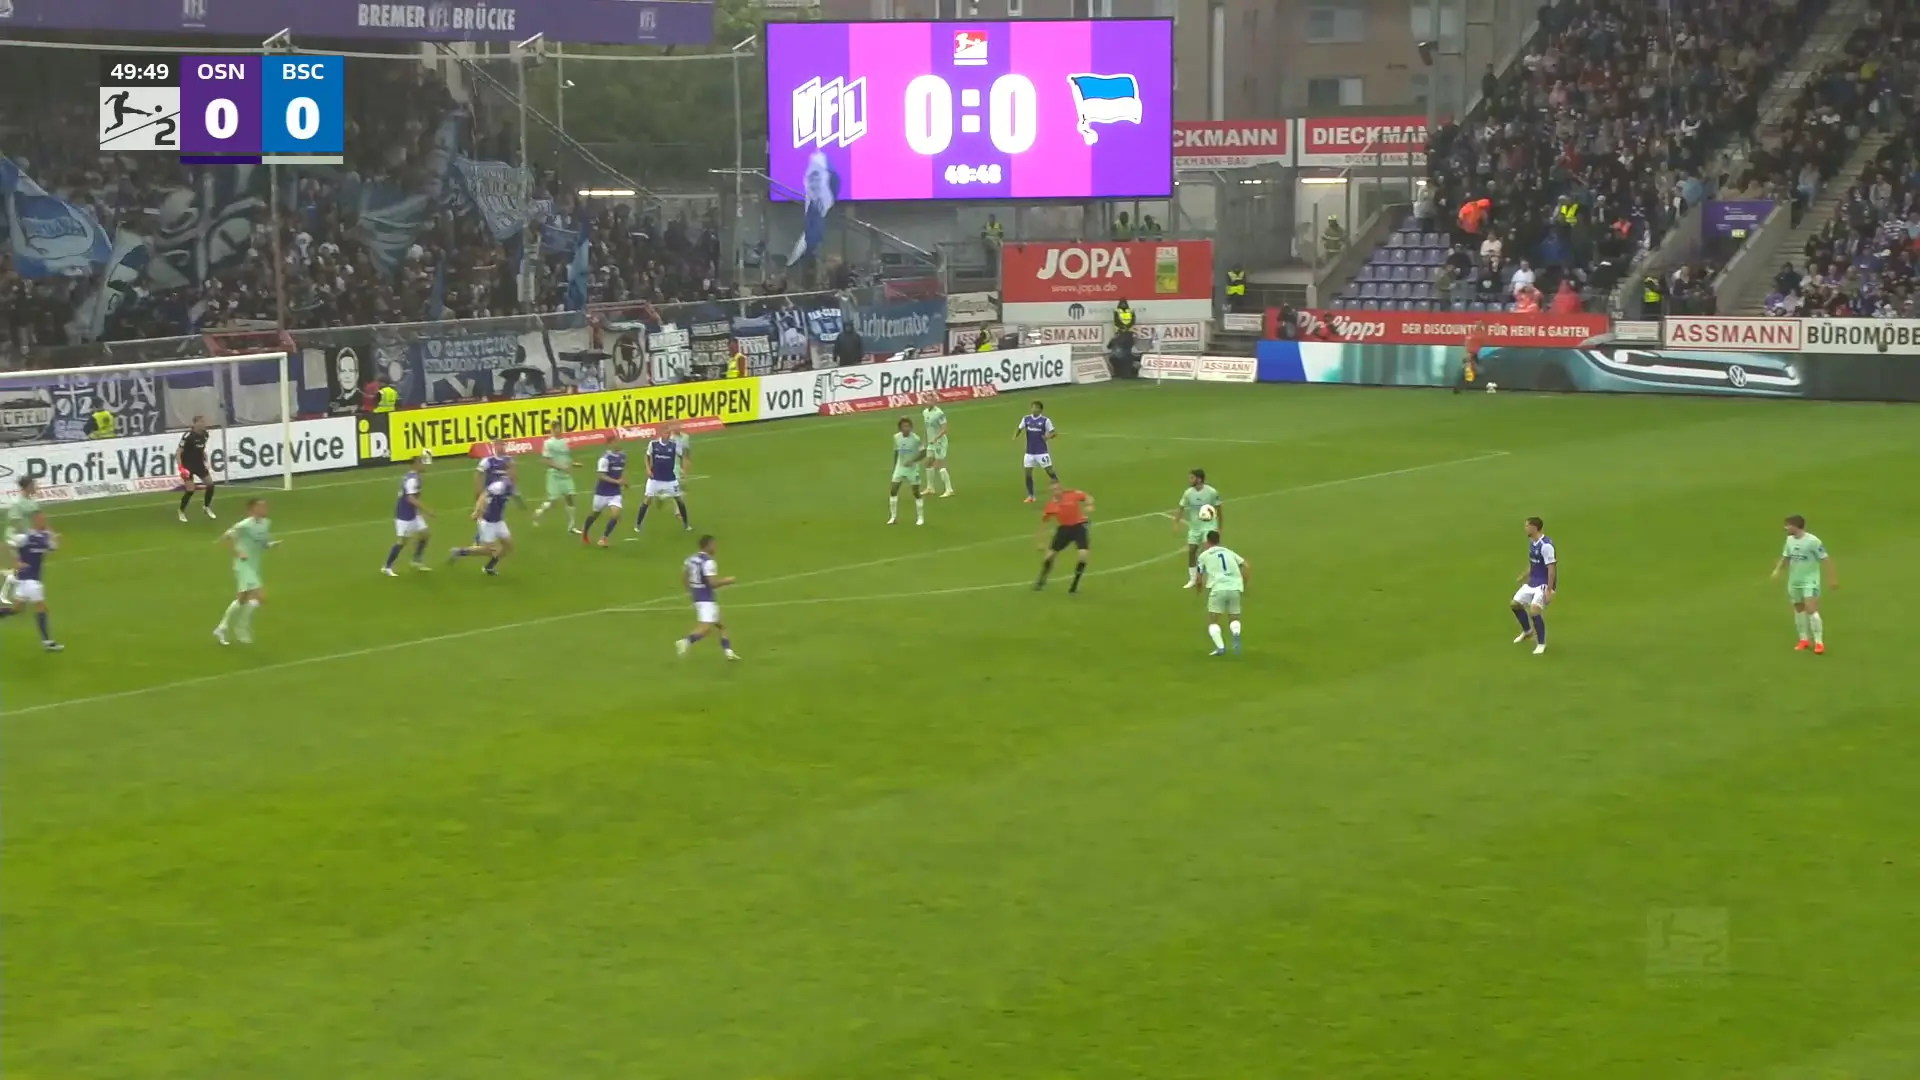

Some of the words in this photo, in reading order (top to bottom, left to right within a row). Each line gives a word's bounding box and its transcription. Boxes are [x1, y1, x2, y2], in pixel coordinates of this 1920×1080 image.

[358, 4, 425, 28] BREMER
[453, 2, 516, 31] BRÜCKE
[1173, 128, 1278, 147] CKMANN
[1312, 126, 1428, 145] DIECKMAN
[1036, 247, 1132, 280] JOPA
[1051, 283, 1118, 294] www.jopa.de
[853, 312, 930, 341] Lichtenrade
[1043, 328, 1099, 343] SMANN
[1296, 311, 1386, 341] Phlipps
[1402, 323, 1421, 335] DER
[1488, 322, 1508, 337] FÜR
[1511, 325, 1536, 337] HEIM
[1538, 326, 1545, 337] &
[1548, 326, 1590, 338] GARTEN
[1671, 323, 1793, 345] ASSMANN
[1807, 322, 1920, 346] BÜROMÖBE
[1147, 359, 1192, 369] ASSMANN
[1204, 362, 1250, 372] ASSMANN
[880, 355, 1063, 396] Profi-Wärme-Service
[767, 388, 803, 411] von
[888, 394, 914, 408] JOPA
[972, 385, 997, 398] JOPA
[602, 387, 751, 428] WÄRMEPUMPEN
[26, 431, 344, 484] Profi-Wäre-Service
[1218, 553, 1227, 572] 1
